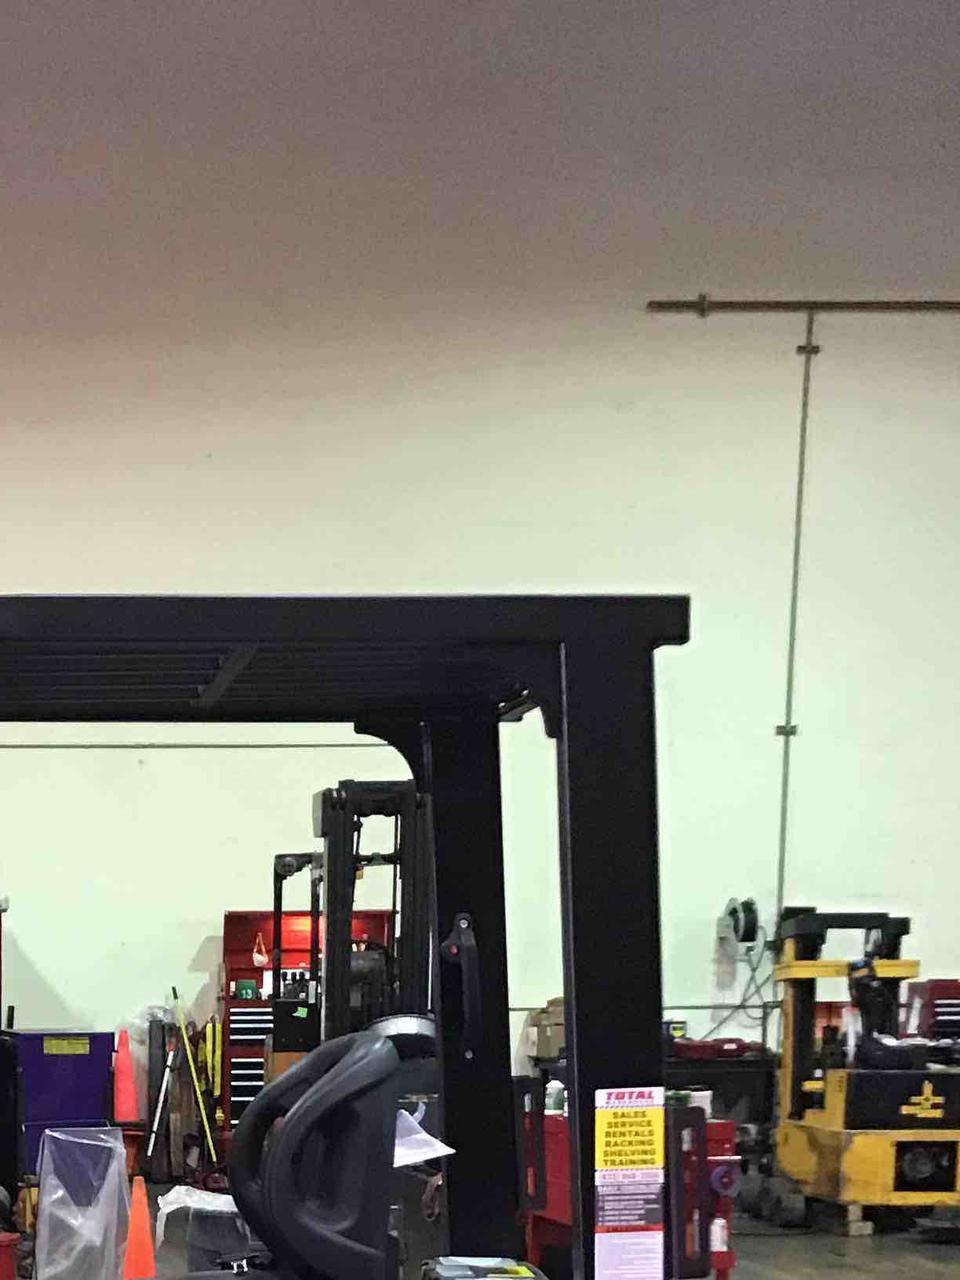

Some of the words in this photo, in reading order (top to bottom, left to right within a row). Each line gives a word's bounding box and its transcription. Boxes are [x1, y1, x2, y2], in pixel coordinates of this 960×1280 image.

[606, 1091, 653, 1100] TOTAL
[613, 1111, 646, 1119] SALES
[607, 1120, 652, 1128] SERVICE
[605, 1130, 654, 1138] RENTALS
[605, 1139, 654, 1147] RACKING
[603, 1148, 656, 1157] SHELVING
[603, 1158, 655, 1166] TRAINING
